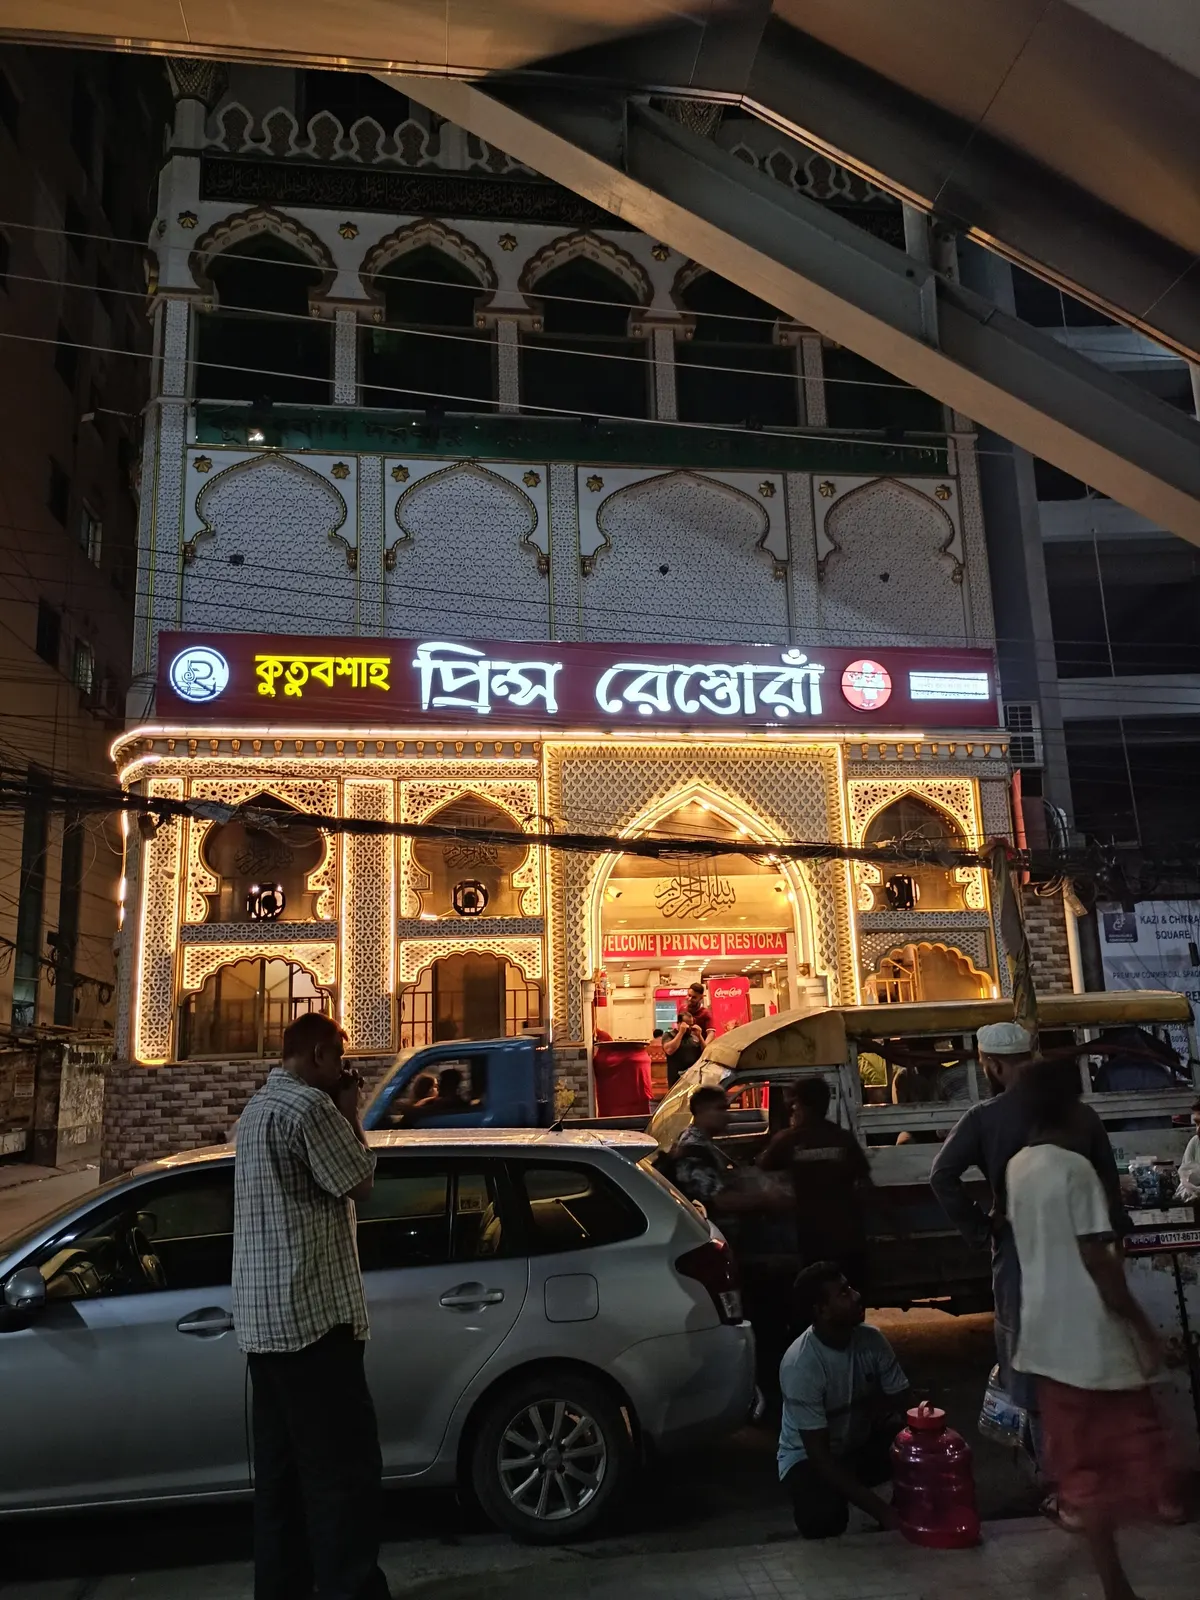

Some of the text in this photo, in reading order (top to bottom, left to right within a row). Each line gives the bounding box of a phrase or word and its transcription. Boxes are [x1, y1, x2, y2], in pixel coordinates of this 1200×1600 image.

[254, 641, 826, 718] কুতুবশাহ প্রিন্স রেস্তোরাঁ
[1140, 915, 1159, 925] KAZI
[1161, 915, 1168, 925] &
[1155, 930, 1191, 940] SQUARE
[662, 933, 720, 951] PRINCE
[727, 933, 784, 949] RESTORA
[1112, 972, 1141, 980] PREMIUM
[1160, 1232, 1200, 1243] 01717-8673
